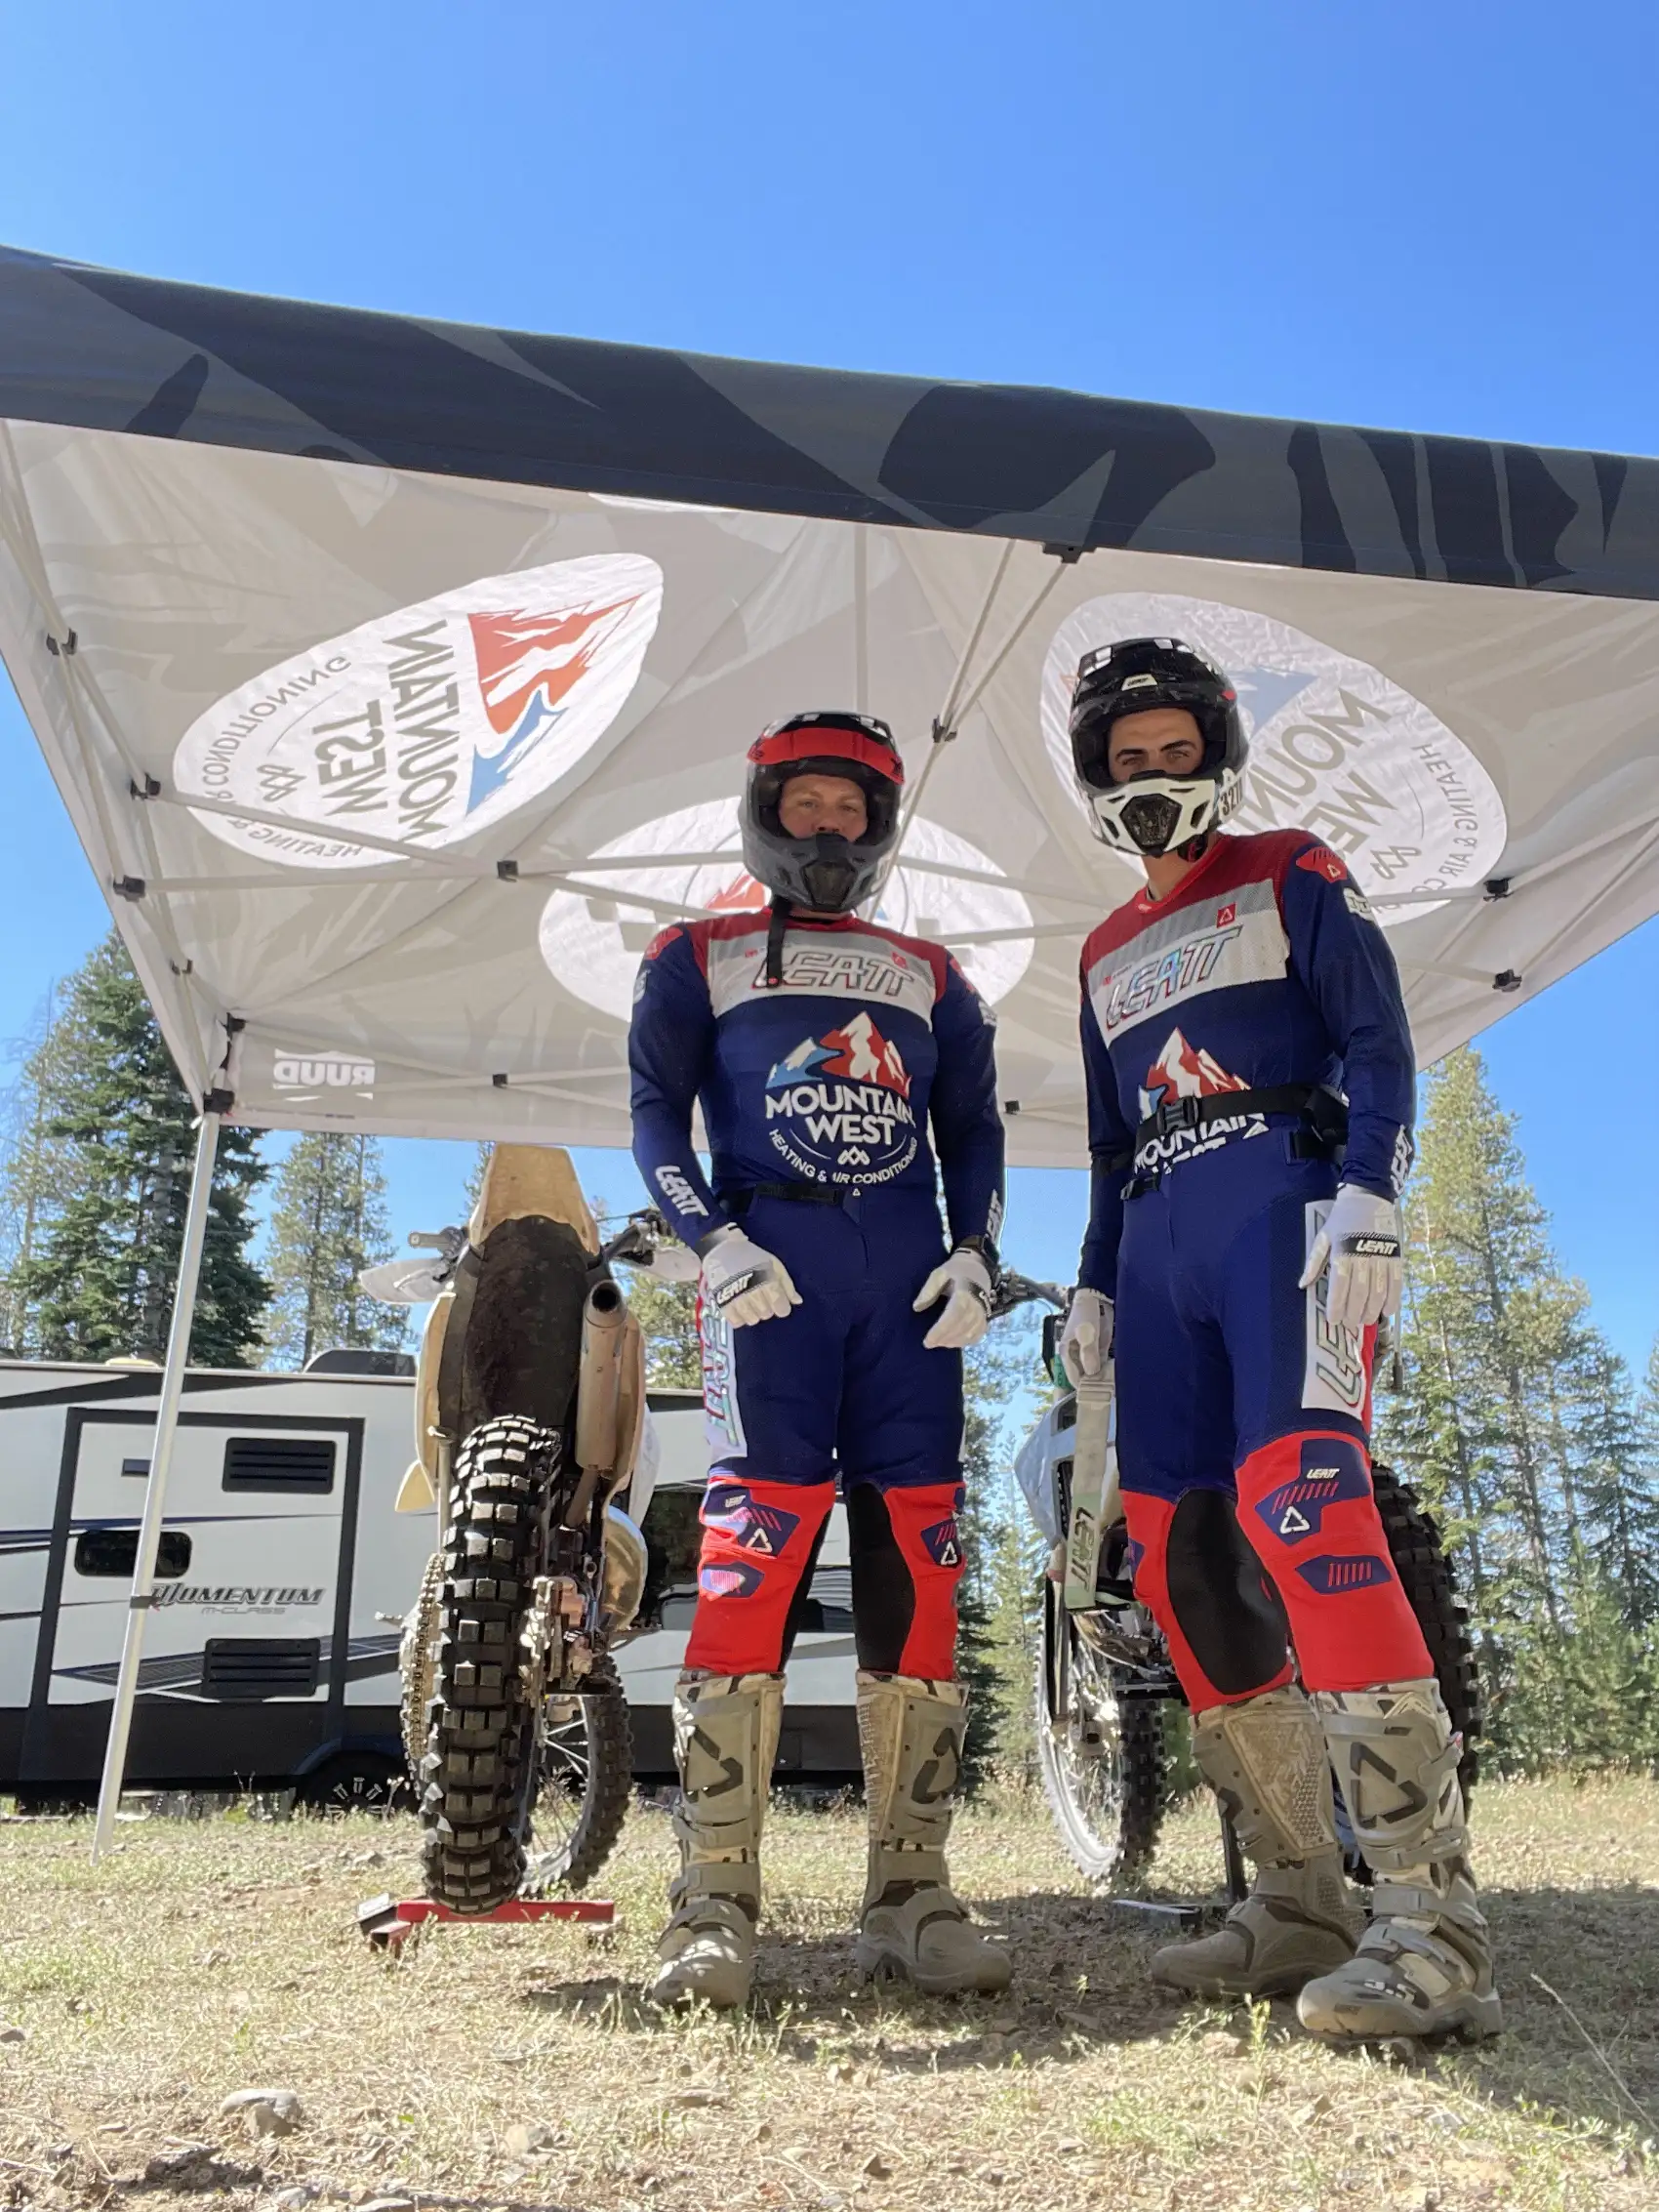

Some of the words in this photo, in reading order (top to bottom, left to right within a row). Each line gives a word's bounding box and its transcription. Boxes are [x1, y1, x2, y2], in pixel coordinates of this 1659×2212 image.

[1106, 923, 1244, 1031] LEATT
[765, 1084, 917, 1129] MOUNTAIN
[804, 1114, 896, 1146] WEST
[769, 1128, 817, 1178] HEATING
[817, 1169, 828, 1183] &
[655, 1165, 709, 1216] LEATT
[1356, 1239, 1398, 1255] LEATT
[716, 1272, 754, 1304] LEATT
[1307, 1467, 1341, 1479] LEATT
[149, 1582, 326, 1607] MOMENTUM
